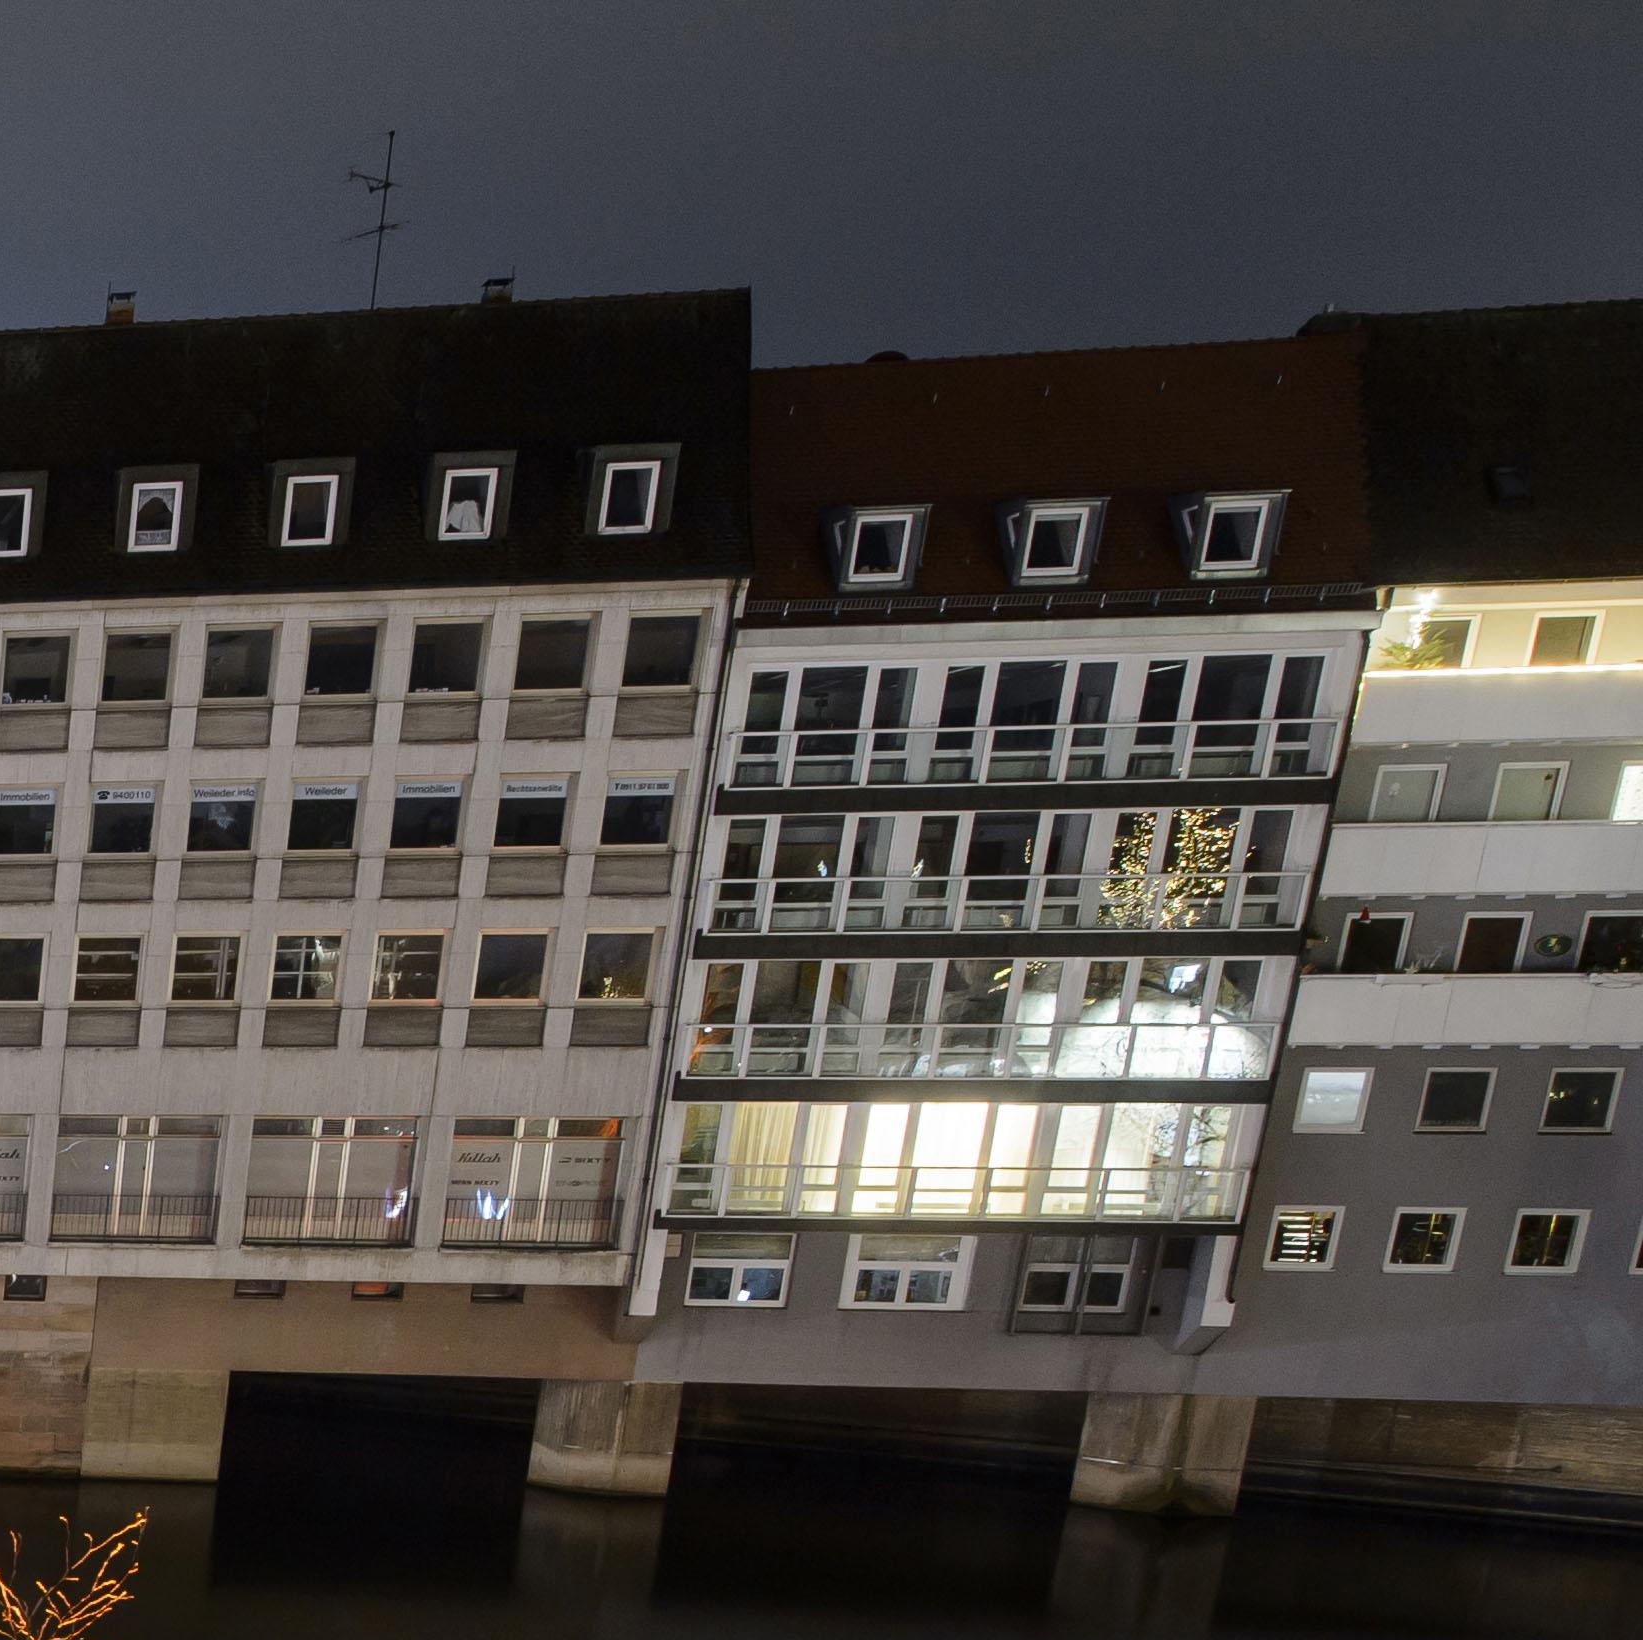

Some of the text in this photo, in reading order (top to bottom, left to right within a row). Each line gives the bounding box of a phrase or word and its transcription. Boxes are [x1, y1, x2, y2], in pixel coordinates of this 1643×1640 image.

[402, 784, 456, 794] Immobilien
[0, 792, 50, 802] Immobilien
[457, 1152, 501, 1163] Killah
